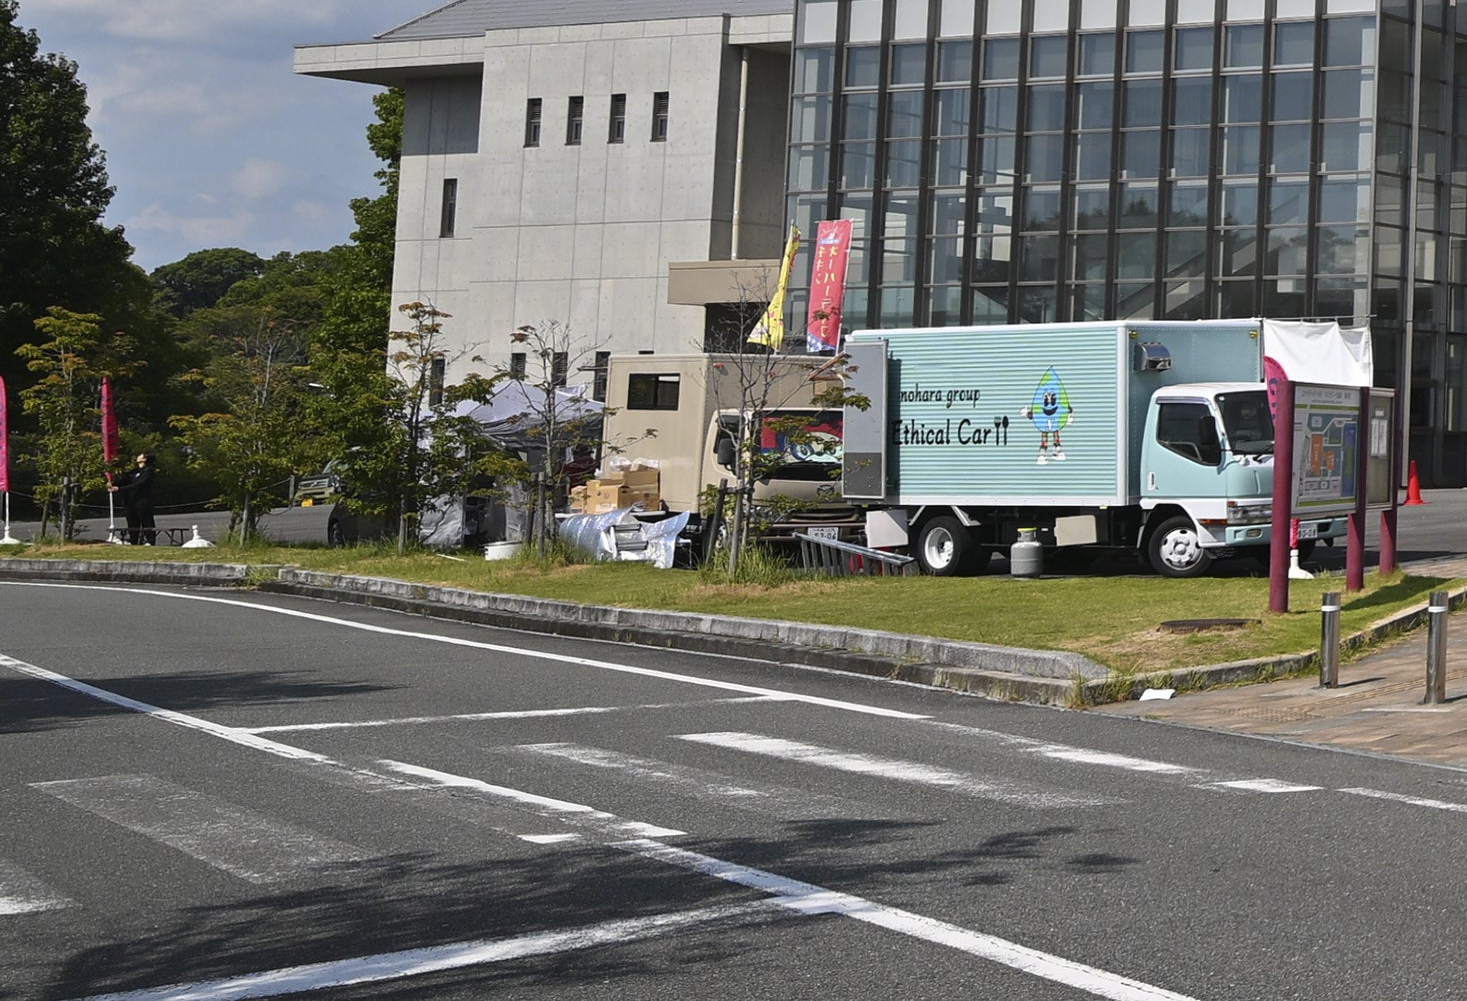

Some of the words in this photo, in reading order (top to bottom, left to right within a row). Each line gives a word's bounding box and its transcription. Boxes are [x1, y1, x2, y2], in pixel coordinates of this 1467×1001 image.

[946, 389, 981, 409] group
[891, 418, 950, 445] Ethical
[958, 418, 992, 445] Car
